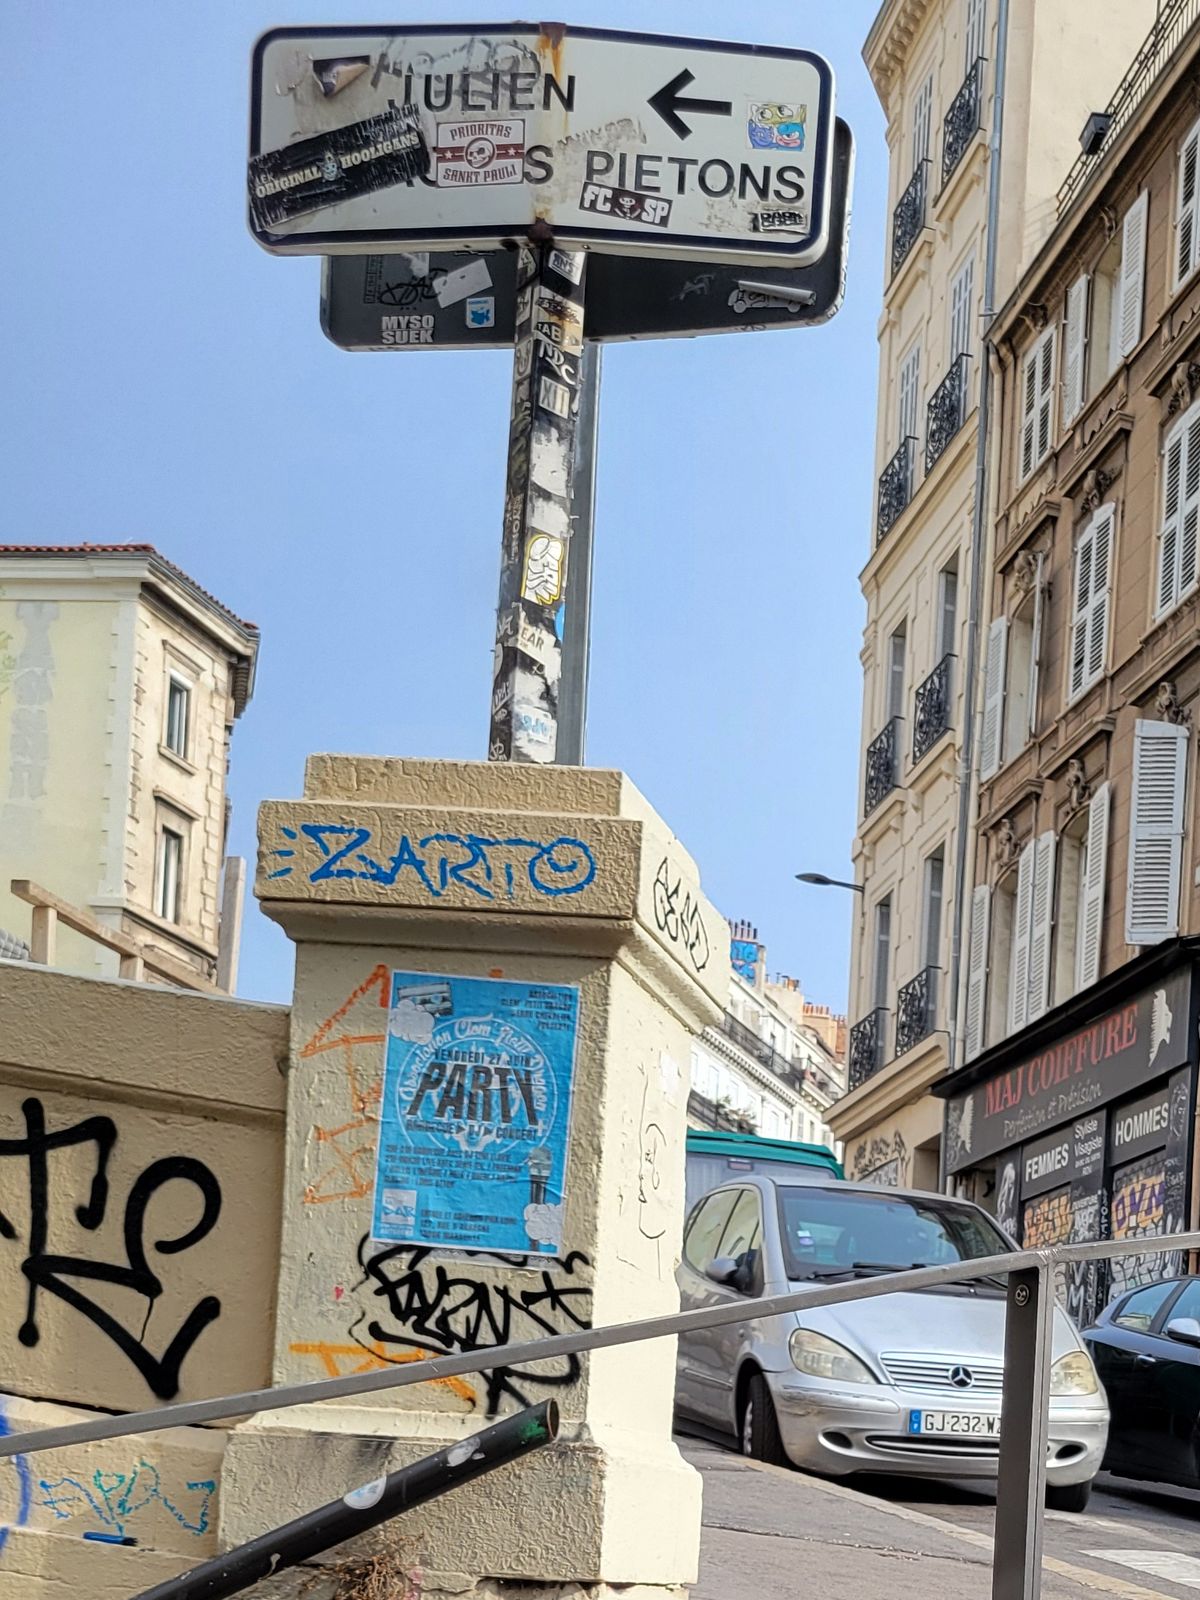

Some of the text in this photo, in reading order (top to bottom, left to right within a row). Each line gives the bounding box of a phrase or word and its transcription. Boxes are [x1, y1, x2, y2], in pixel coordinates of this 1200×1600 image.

[255, 166, 322, 198] ORIGINAL
[340, 132, 420, 169] HOOLIGANS
[443, 164, 517, 183] SANKT PAULI
[586, 150, 805, 205] PIETONS
[381, 314, 435, 330] MYSO
[381, 330, 435, 345] SUEK
[983, 1003, 1139, 1119] MAJ COIFFURE
[406, 1062, 540, 1127] PARTY
[1115, 1102, 1169, 1147] HOMMES
[1025, 1143, 1070, 1183] FEMMES
